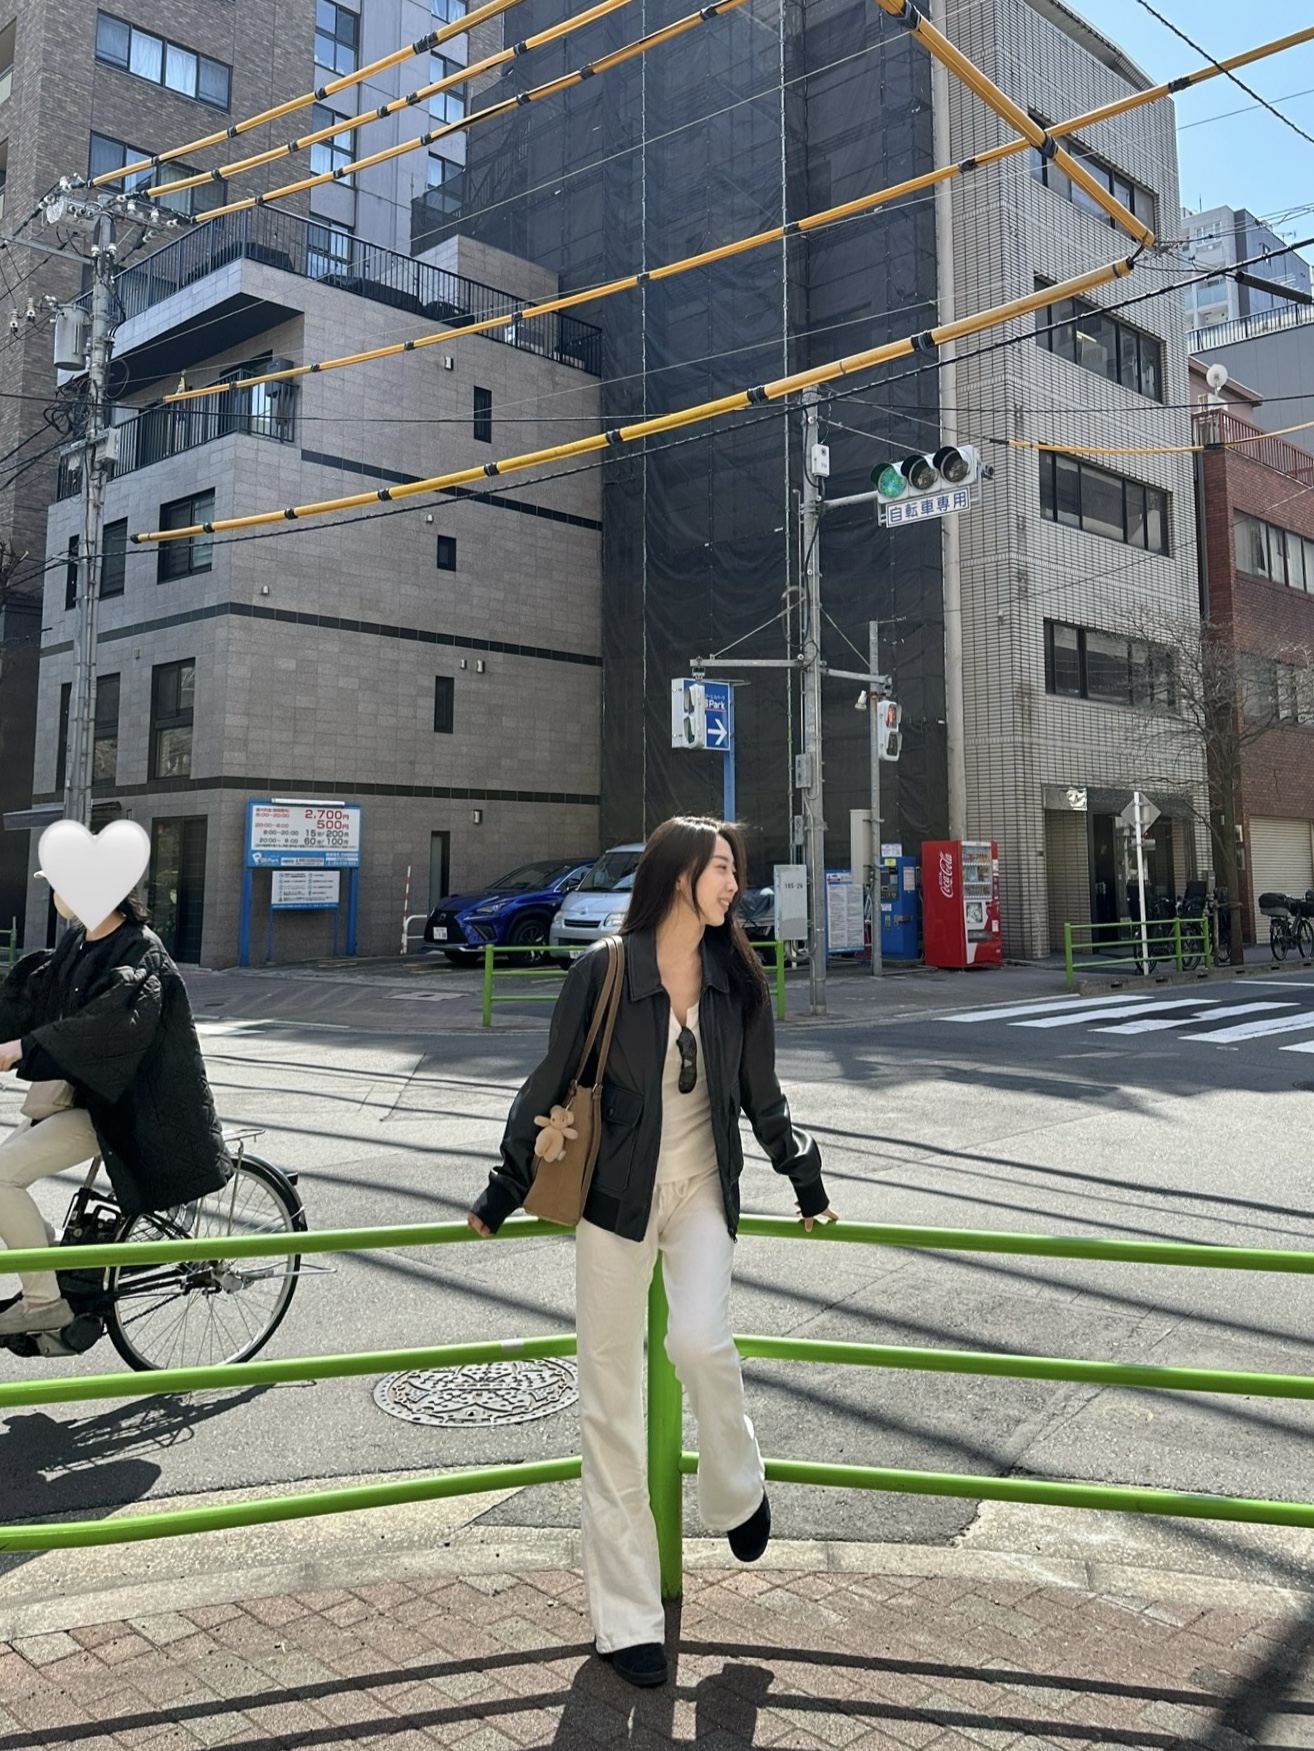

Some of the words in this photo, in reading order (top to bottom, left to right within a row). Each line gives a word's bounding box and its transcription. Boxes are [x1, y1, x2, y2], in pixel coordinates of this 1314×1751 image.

[890, 491, 967, 523] 自転車専用
[304, 809, 350, 820] 2,700円
[316, 820, 350, 830] 500円
